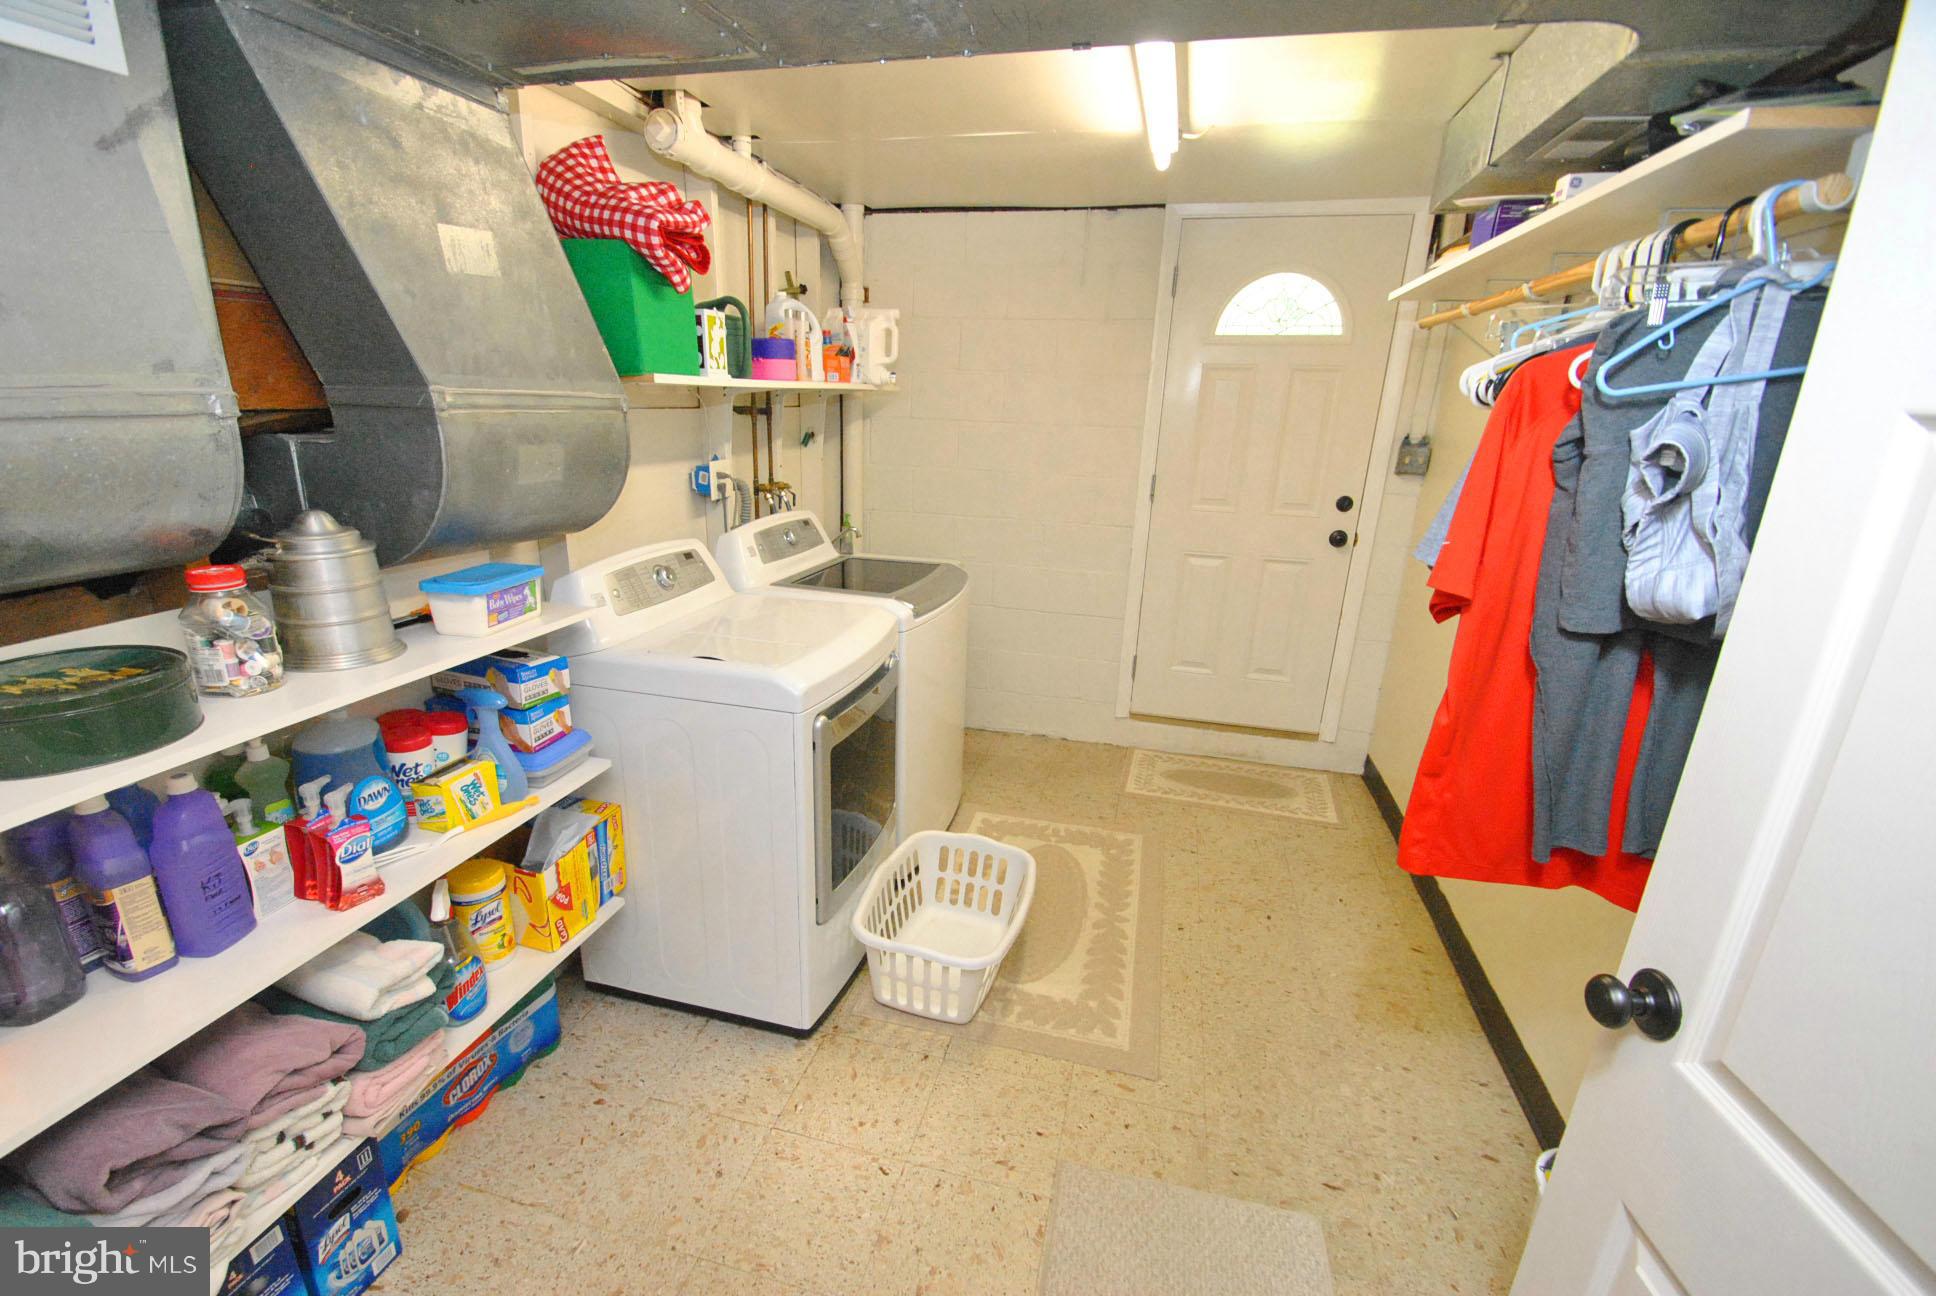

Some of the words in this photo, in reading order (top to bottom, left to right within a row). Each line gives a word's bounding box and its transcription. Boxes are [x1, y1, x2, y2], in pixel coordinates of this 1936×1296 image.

[357, 784, 391, 808] DAWN
[341, 836, 372, 858] Dial
[470, 901, 501, 928] Lysol
[556, 919, 568, 943] GLAD
[446, 965, 484, 1013] Windex
[458, 1043, 489, 1069] Viruses
[498, 1010, 529, 1037] Bacteria
[450, 1053, 493, 1105] CLOROX
[335, 1170, 344, 1183] 4
[322, 1217, 350, 1252] Lysol
